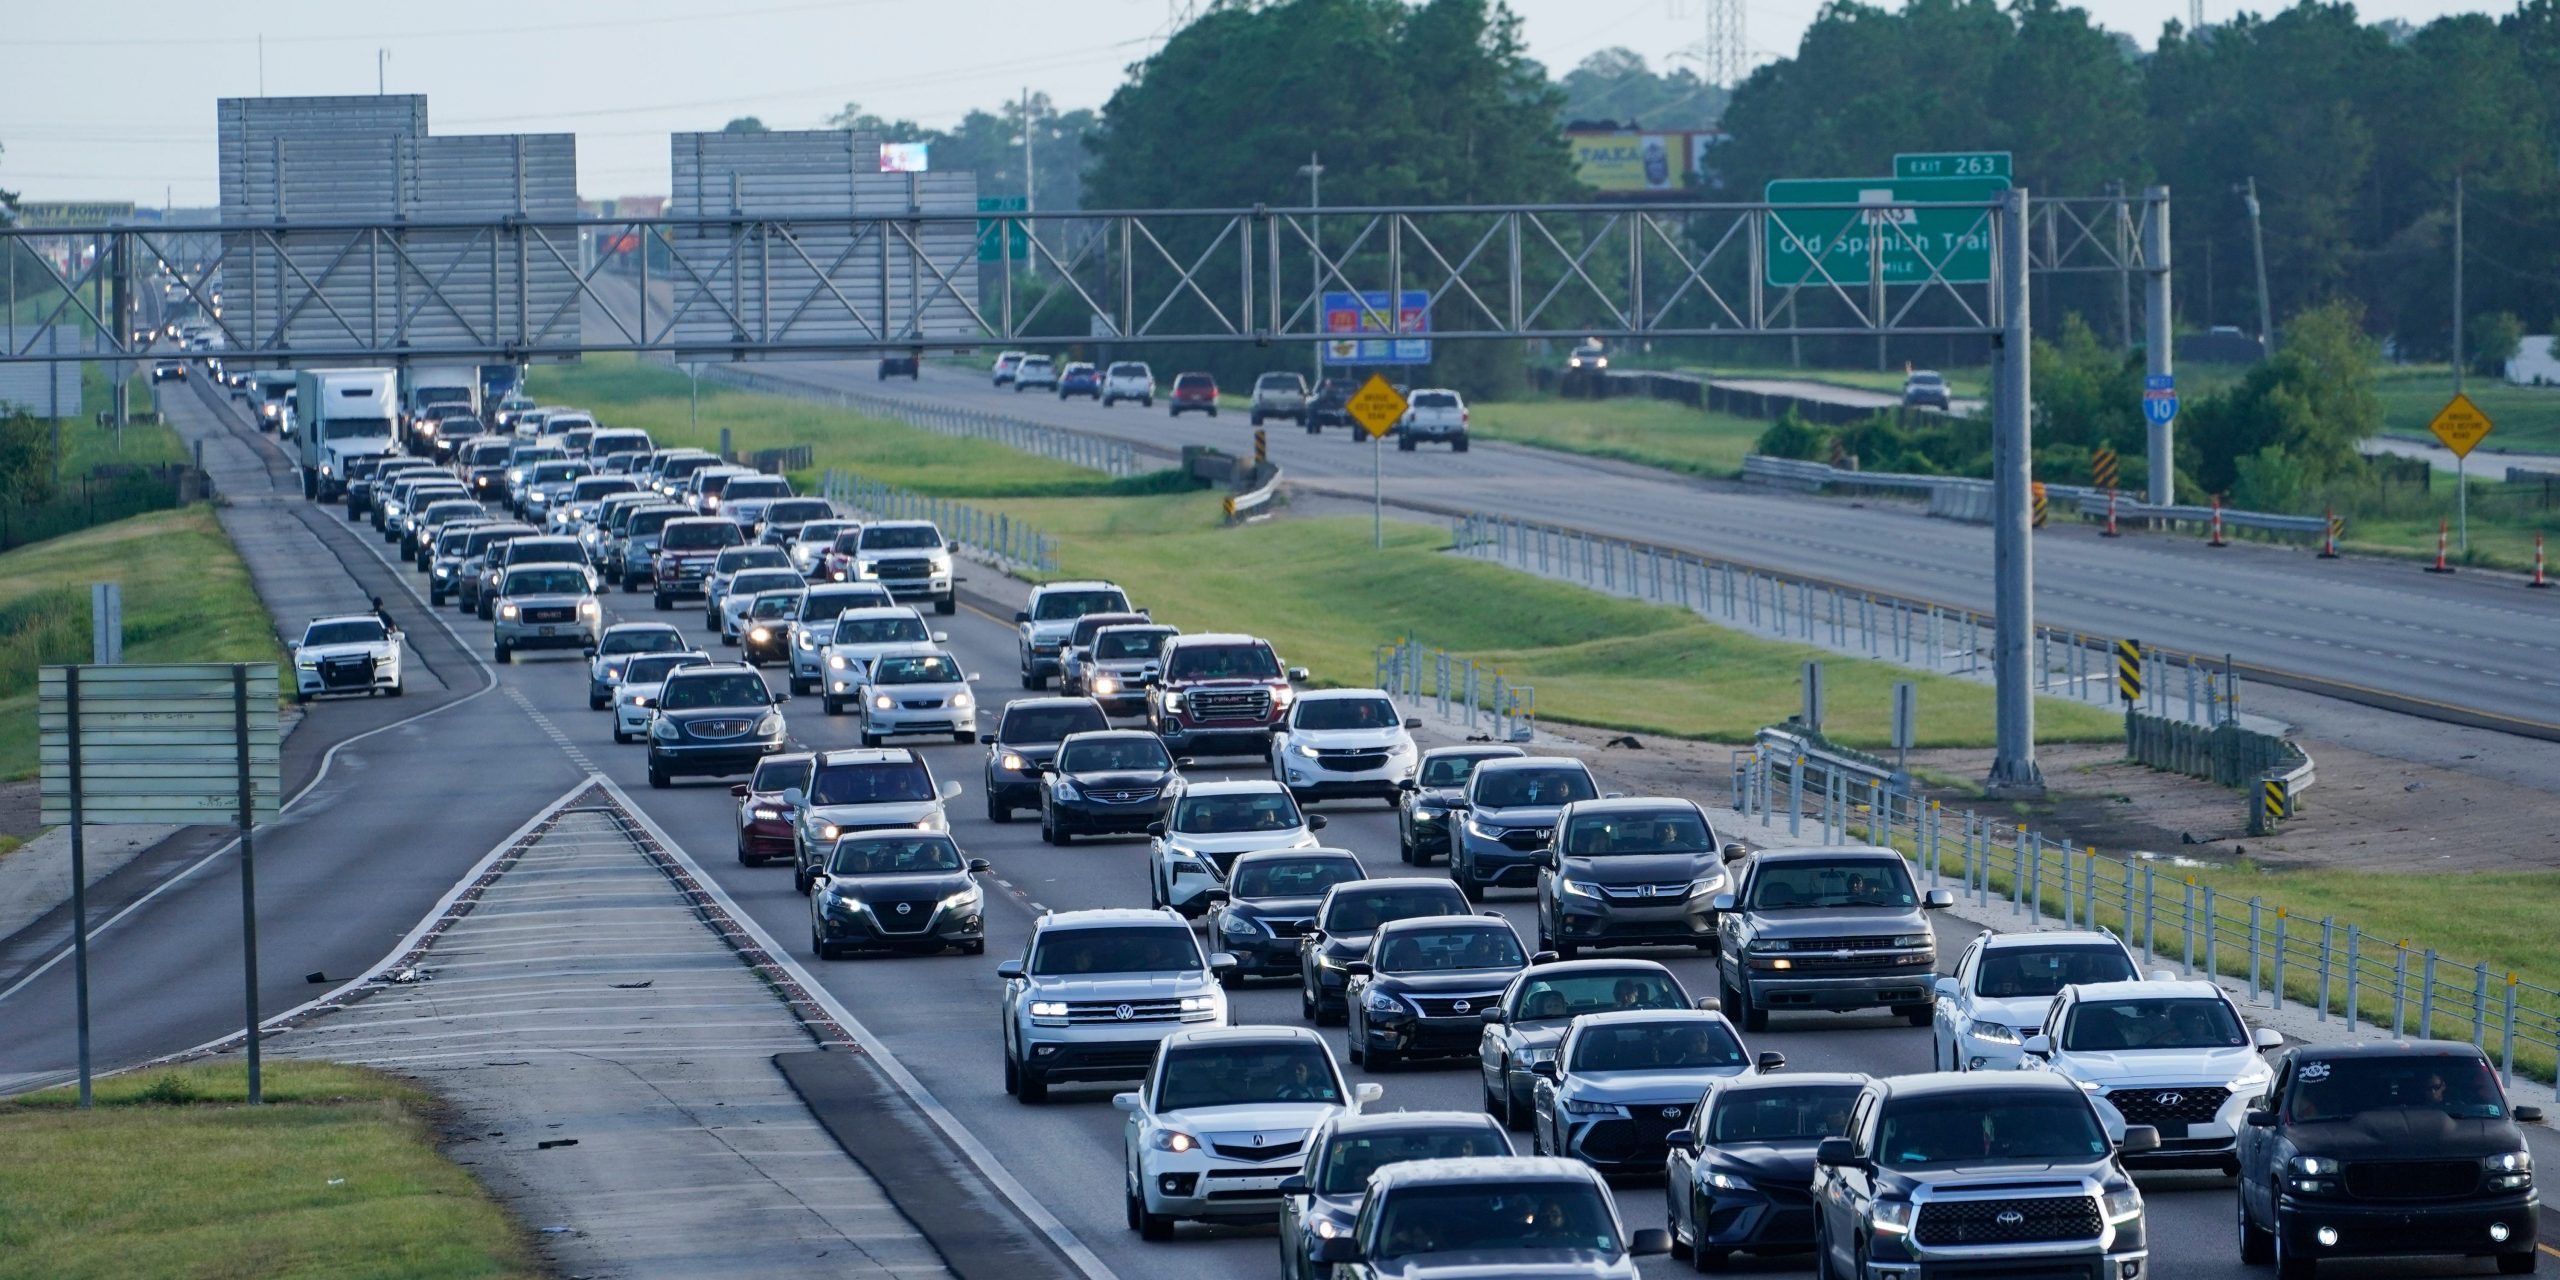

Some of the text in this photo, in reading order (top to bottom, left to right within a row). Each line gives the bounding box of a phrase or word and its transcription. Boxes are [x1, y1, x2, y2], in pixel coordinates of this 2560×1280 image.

[1910, 158, 1994, 174] EXIT 263
[1780, 234, 1821, 254] Old
[2153, 399, 2171, 419] 10
[1213, 695, 1247, 703] GMC
